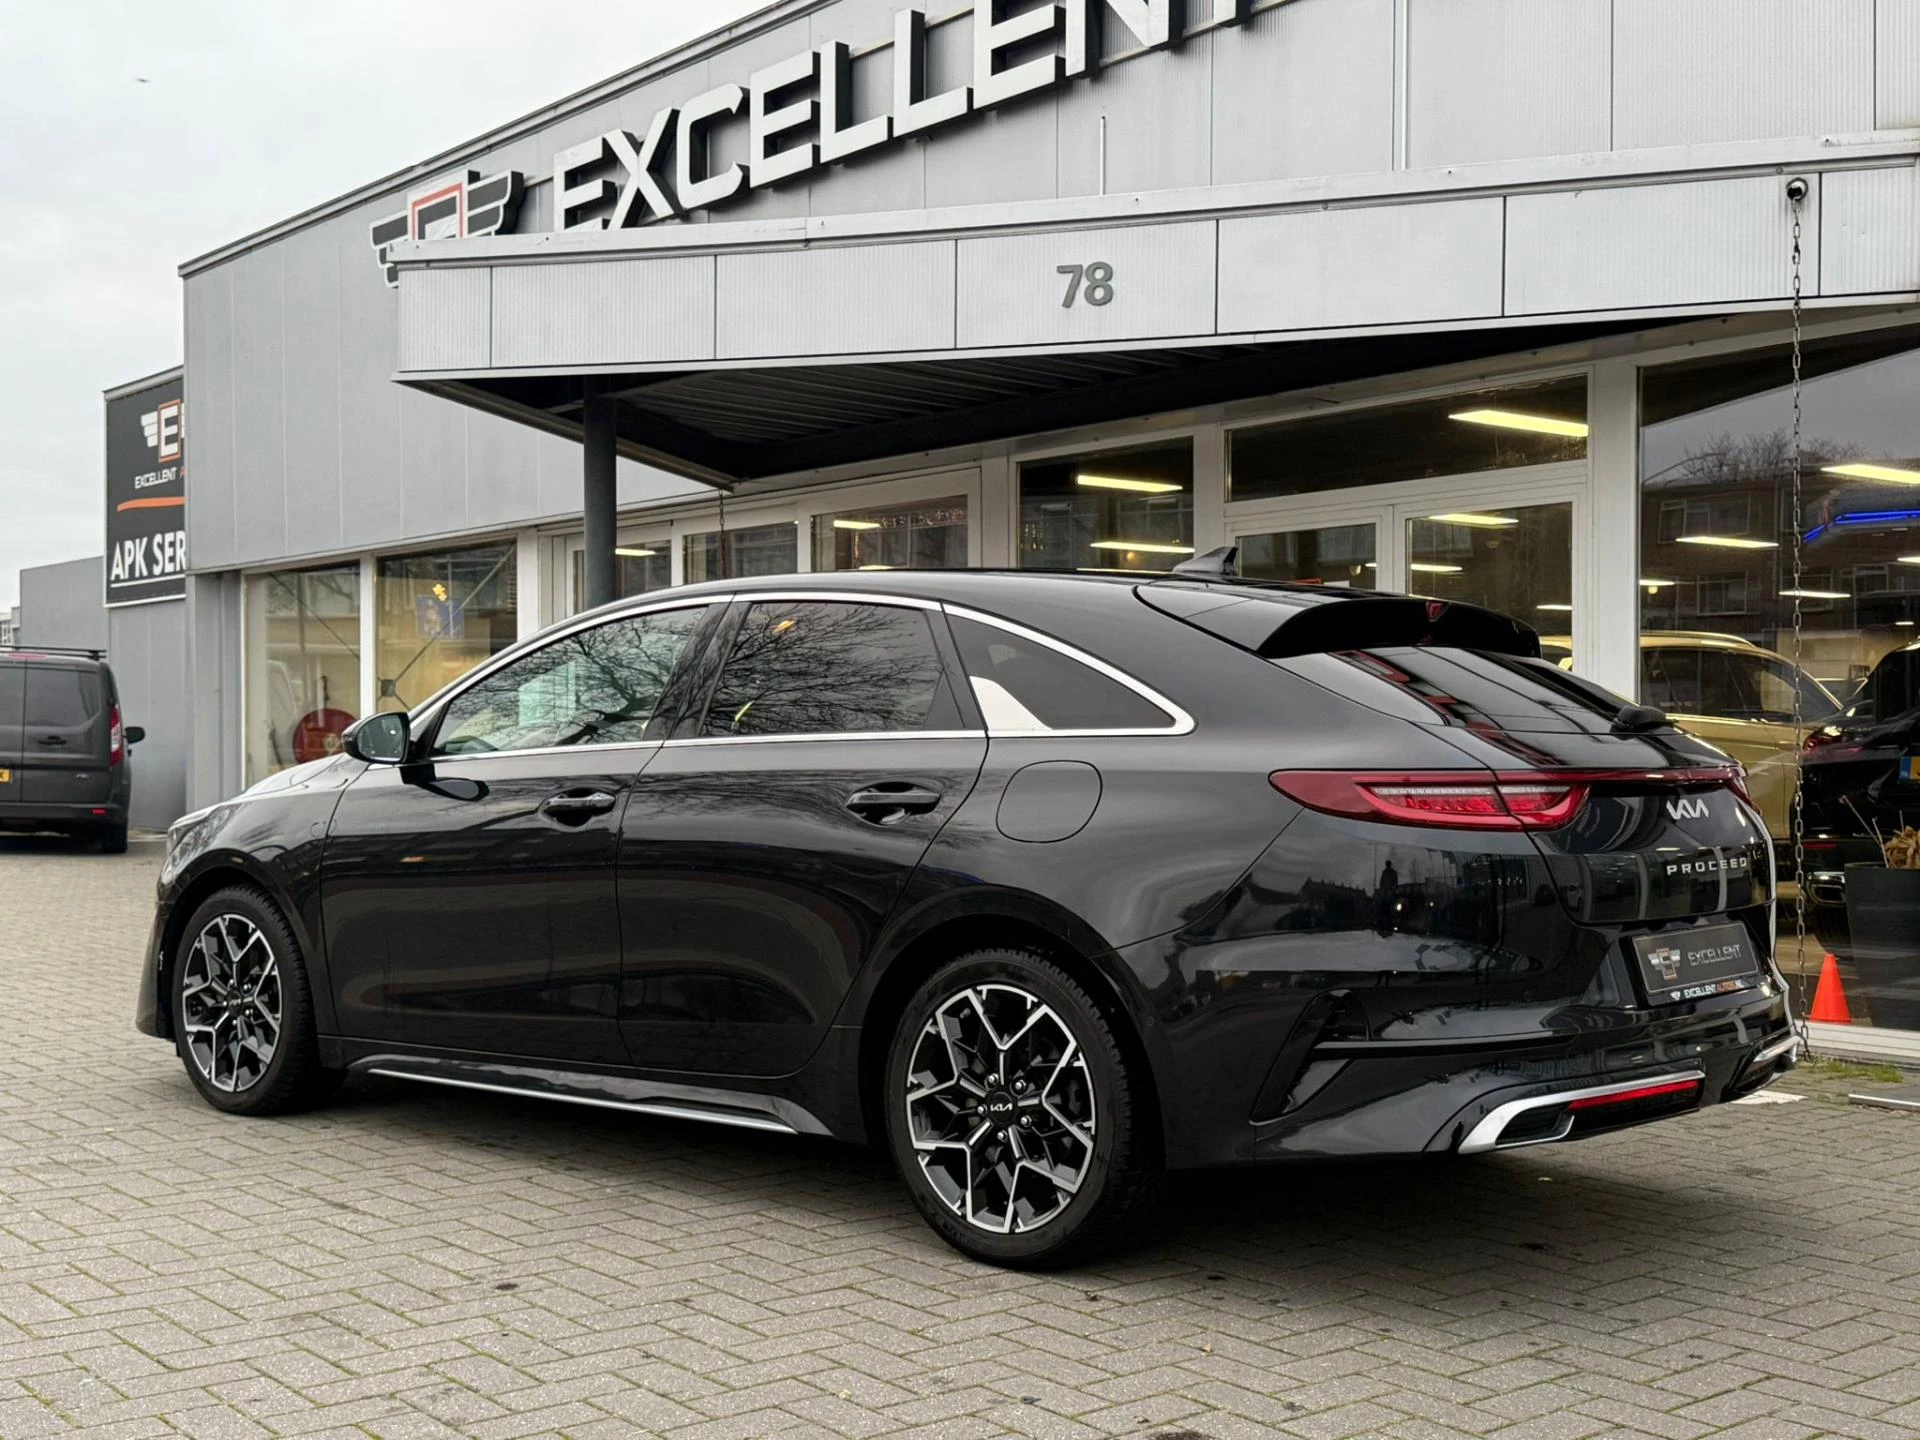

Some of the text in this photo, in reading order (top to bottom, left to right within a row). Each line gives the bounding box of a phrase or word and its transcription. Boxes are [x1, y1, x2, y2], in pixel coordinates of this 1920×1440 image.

[553, 0, 1237, 232] EXCELLEN
[1056, 261, 1113, 308] 78
[134, 466, 177, 489] EXCELLENT
[110, 530, 186, 581] APK SER
[1666, 798, 1710, 820] KIA
[1666, 857, 1747, 876] PROCEED
[1687, 944, 1742, 966] EXCELLENT
[990, 1102, 1013, 1111] KIA
